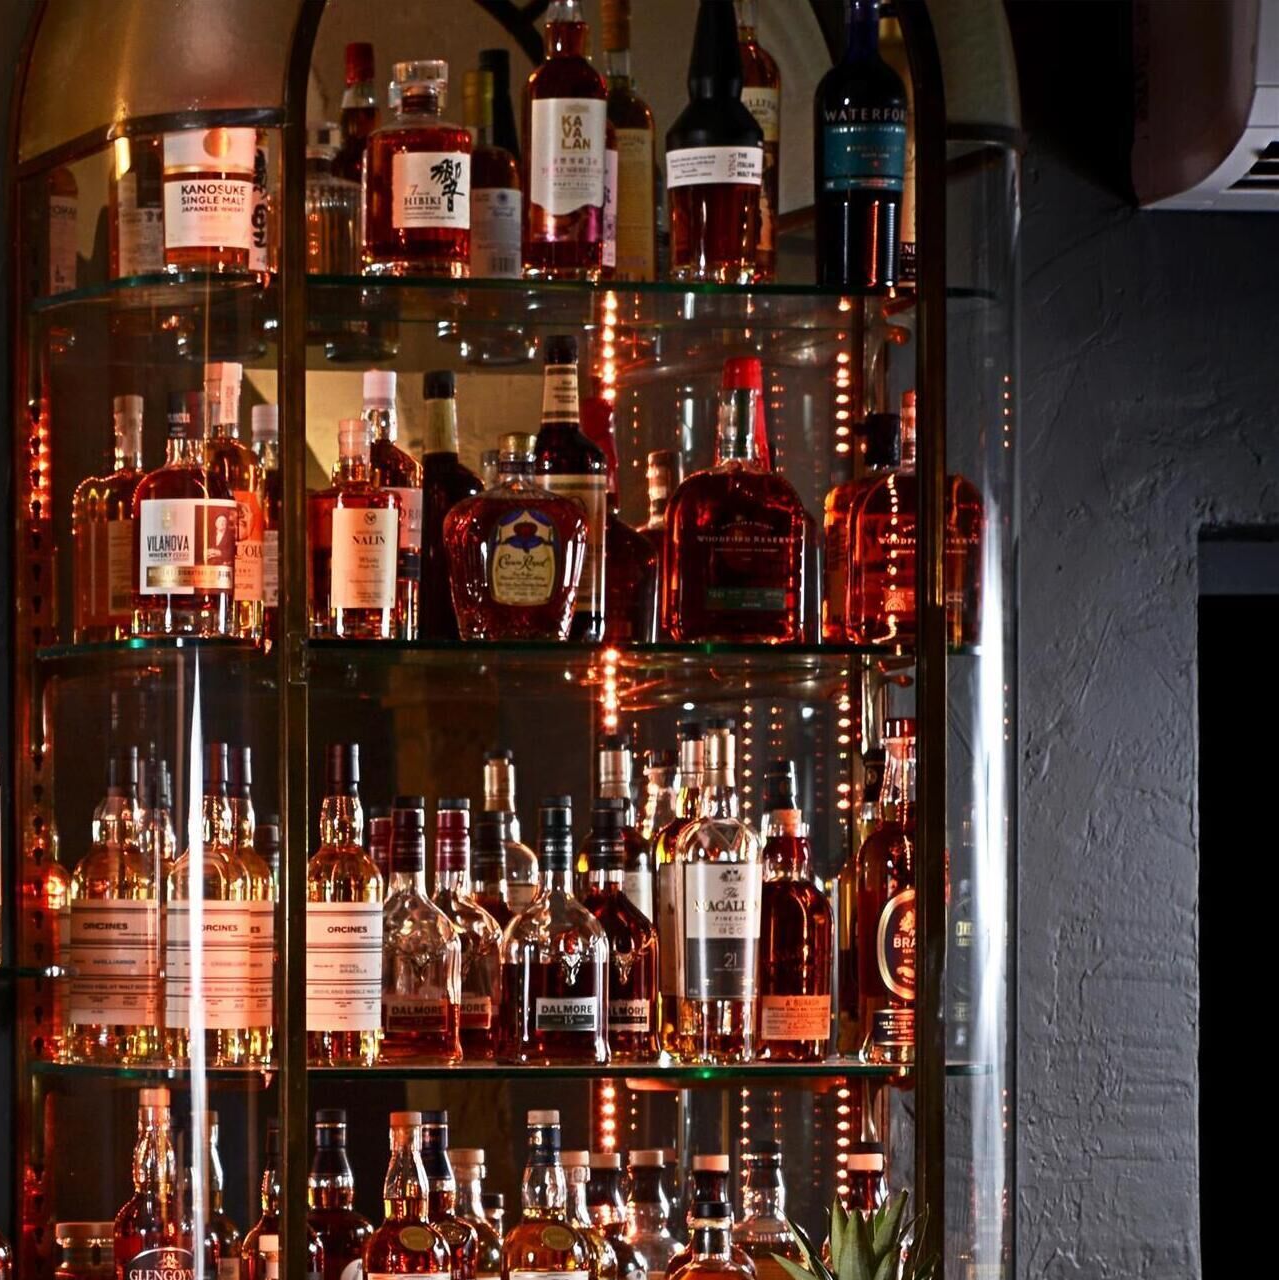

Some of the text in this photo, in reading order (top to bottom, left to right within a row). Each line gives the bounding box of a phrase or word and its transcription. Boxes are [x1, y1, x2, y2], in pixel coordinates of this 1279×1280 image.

[561, 114, 583, 127] KA
[562, 126, 583, 139] VA
[560, 138, 591, 150] LAN
[180, 184, 246, 196] KANOSUKE
[181, 196, 246, 206] SINGLE MALT
[403, 196, 442, 206] HIBIKI
[146, 534, 190, 551] VILANOVA
[351, 535, 387, 545] NALIN
[696, 535, 796, 544] WOODFORD RESERVE
[723, 887, 739, 899] The
[326, 925, 369, 934] ORCINES
[723, 952, 737, 968] 21
[390, 1004, 444, 1016] DALMORE
[541, 1003, 593, 1015] DALMORE
